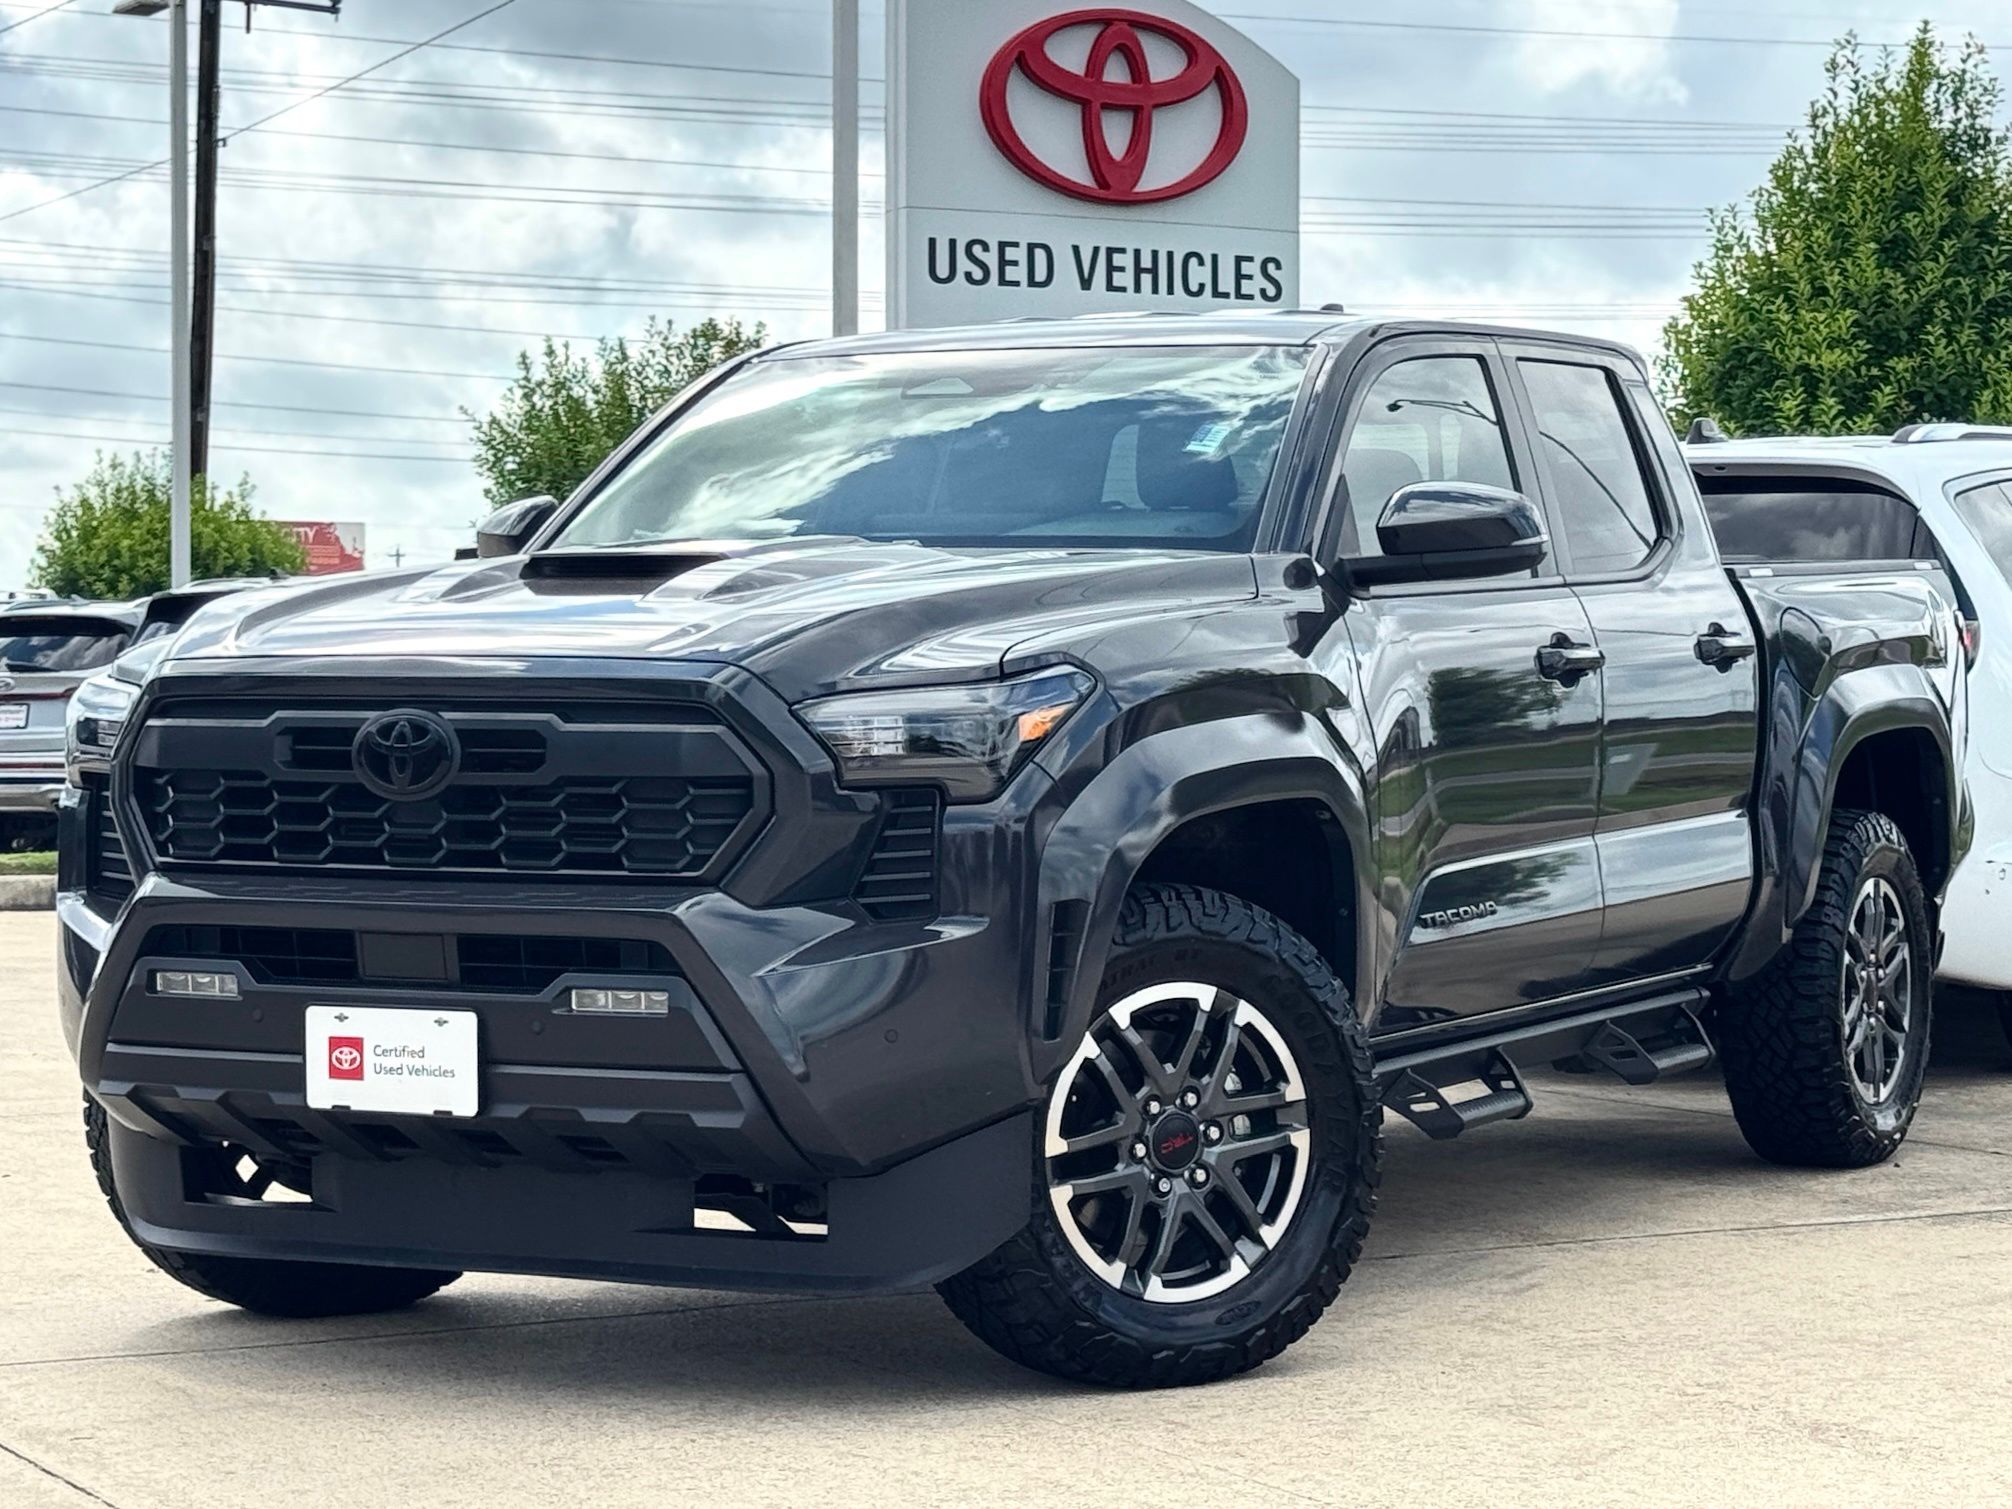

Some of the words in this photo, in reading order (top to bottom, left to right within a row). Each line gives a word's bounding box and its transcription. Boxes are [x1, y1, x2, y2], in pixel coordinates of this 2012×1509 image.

[928, 237, 1055, 289] USED
[1072, 244, 1283, 303] VEHICLES
[1420, 901, 1497, 926] TACOMA
[373, 1044, 425, 1059] Certified
[373, 1062, 404, 1076] Used
[407, 1064, 456, 1078] Vehicles
